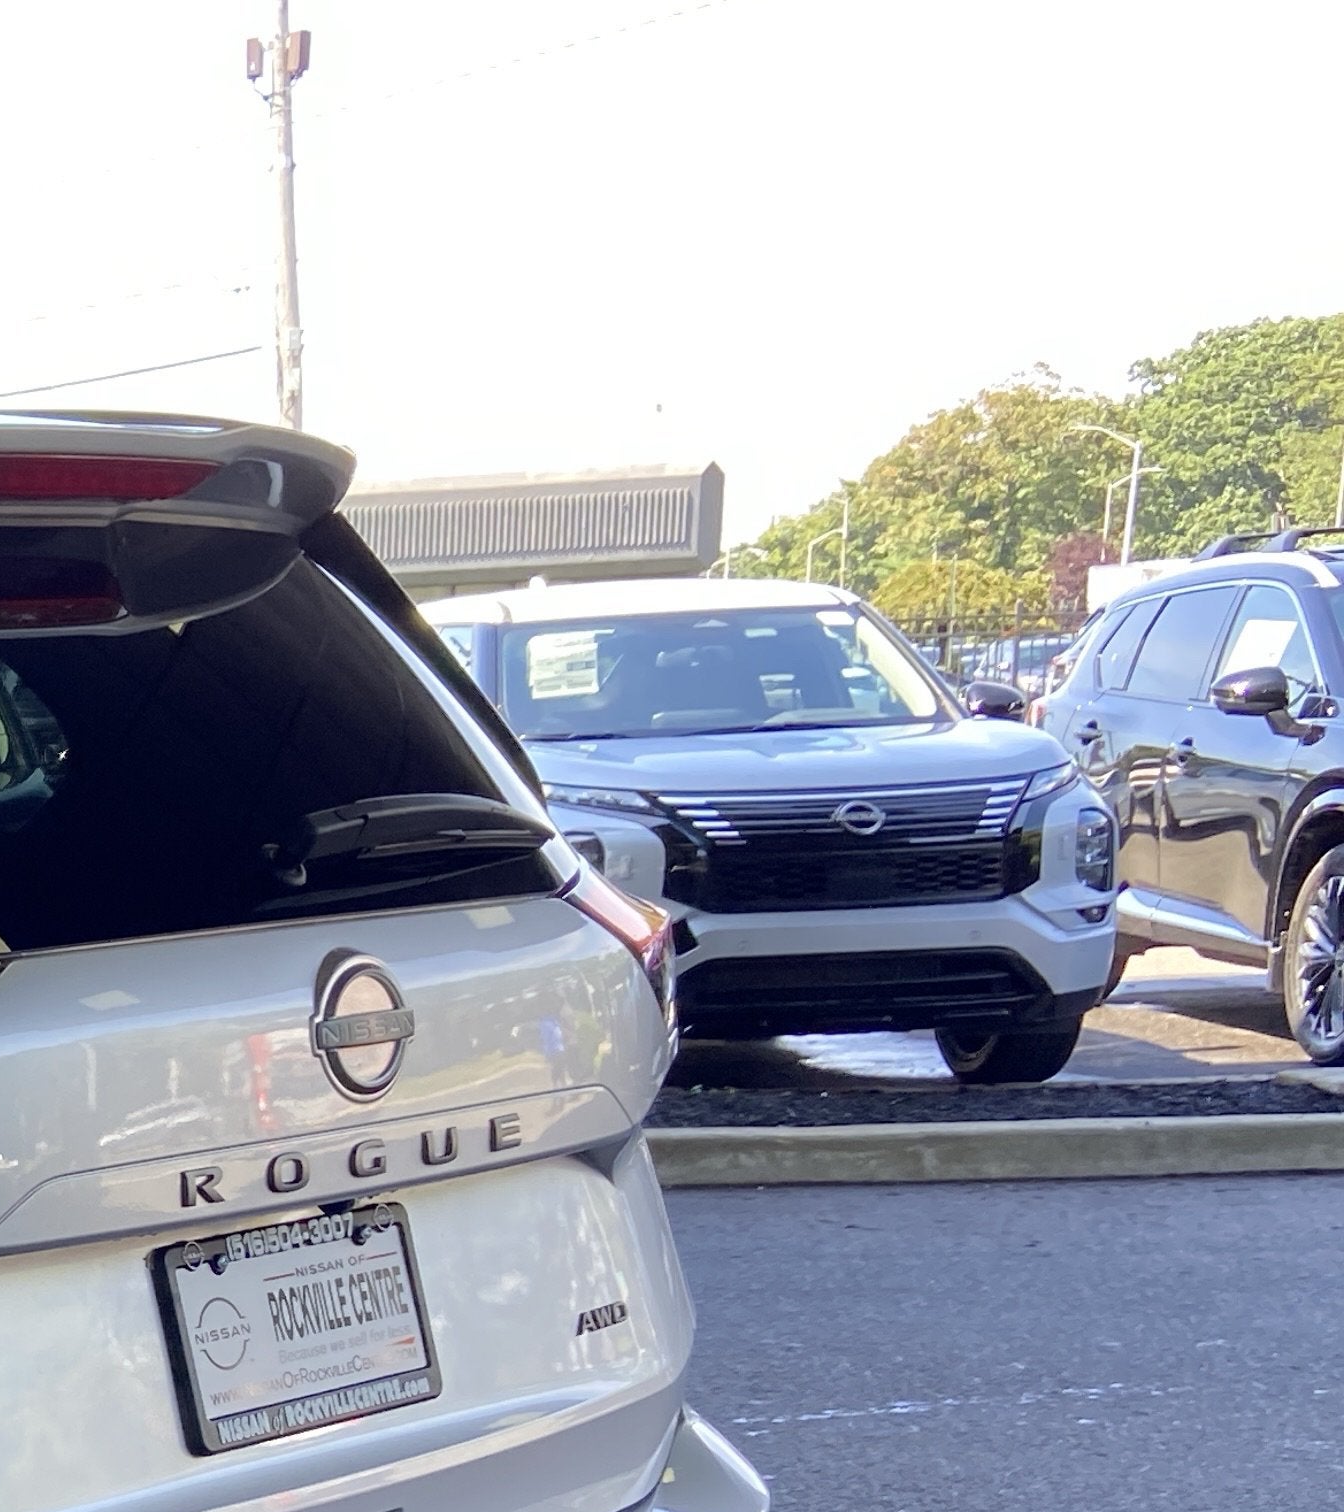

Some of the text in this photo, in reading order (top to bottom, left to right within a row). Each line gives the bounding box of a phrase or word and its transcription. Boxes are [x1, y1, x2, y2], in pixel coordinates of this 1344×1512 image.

[321, 1010, 414, 1045] NISSAN
[180, 1112, 523, 1207] ROGUE
[295, 1255, 366, 1278] NISSAN OF
[267, 1266, 408, 1342] ROCKVILLE CENTRE
[576, 1300, 629, 1336] AWD
[194, 1323, 251, 1344] NISSAN
[217, 1410, 270, 1444] NISSAN
